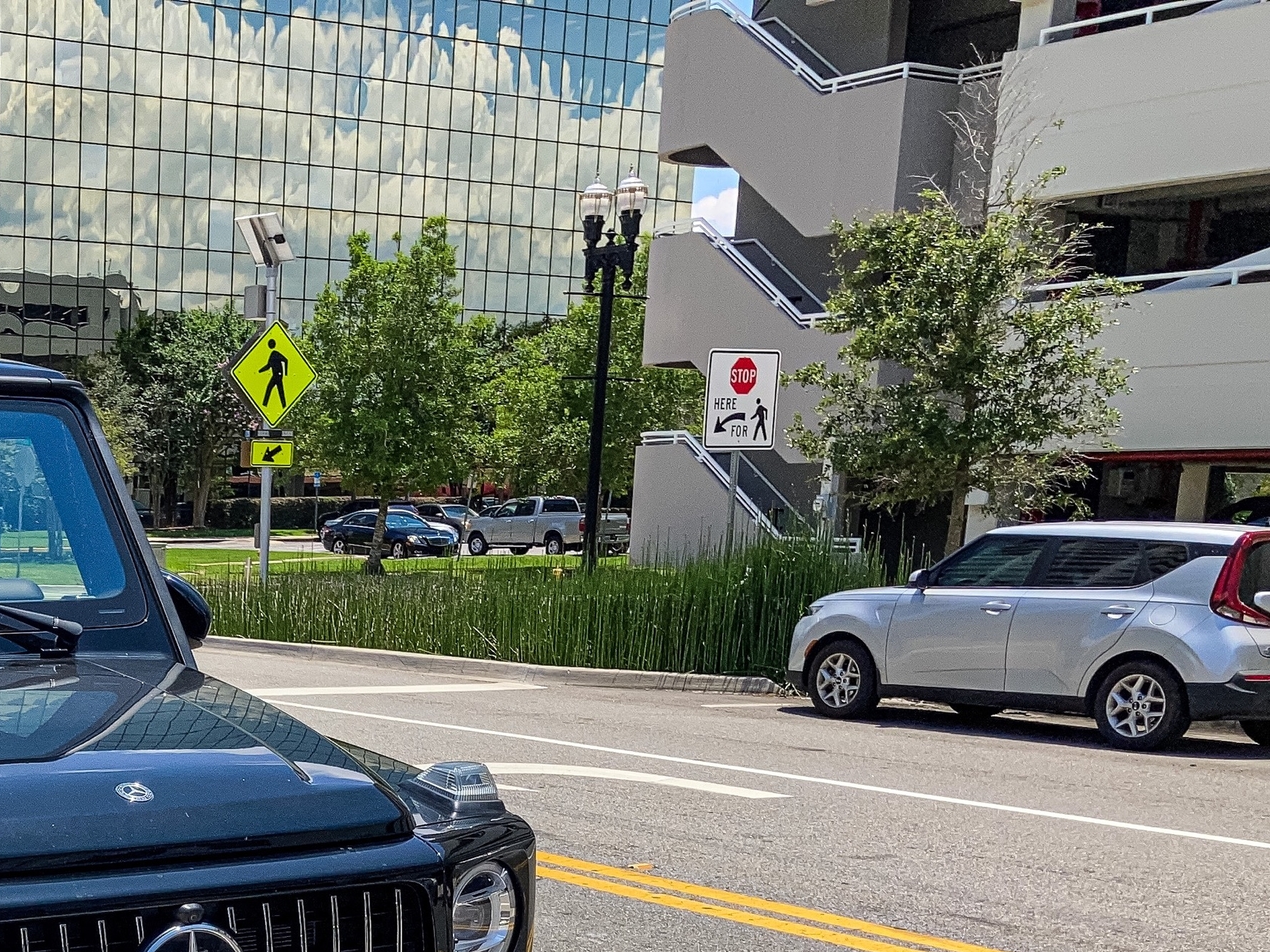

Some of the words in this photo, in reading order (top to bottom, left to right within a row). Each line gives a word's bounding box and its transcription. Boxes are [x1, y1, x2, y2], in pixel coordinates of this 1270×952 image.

[731, 368, 756, 384] STOP
[714, 397, 737, 410] HERE
[730, 424, 748, 437] FOR
